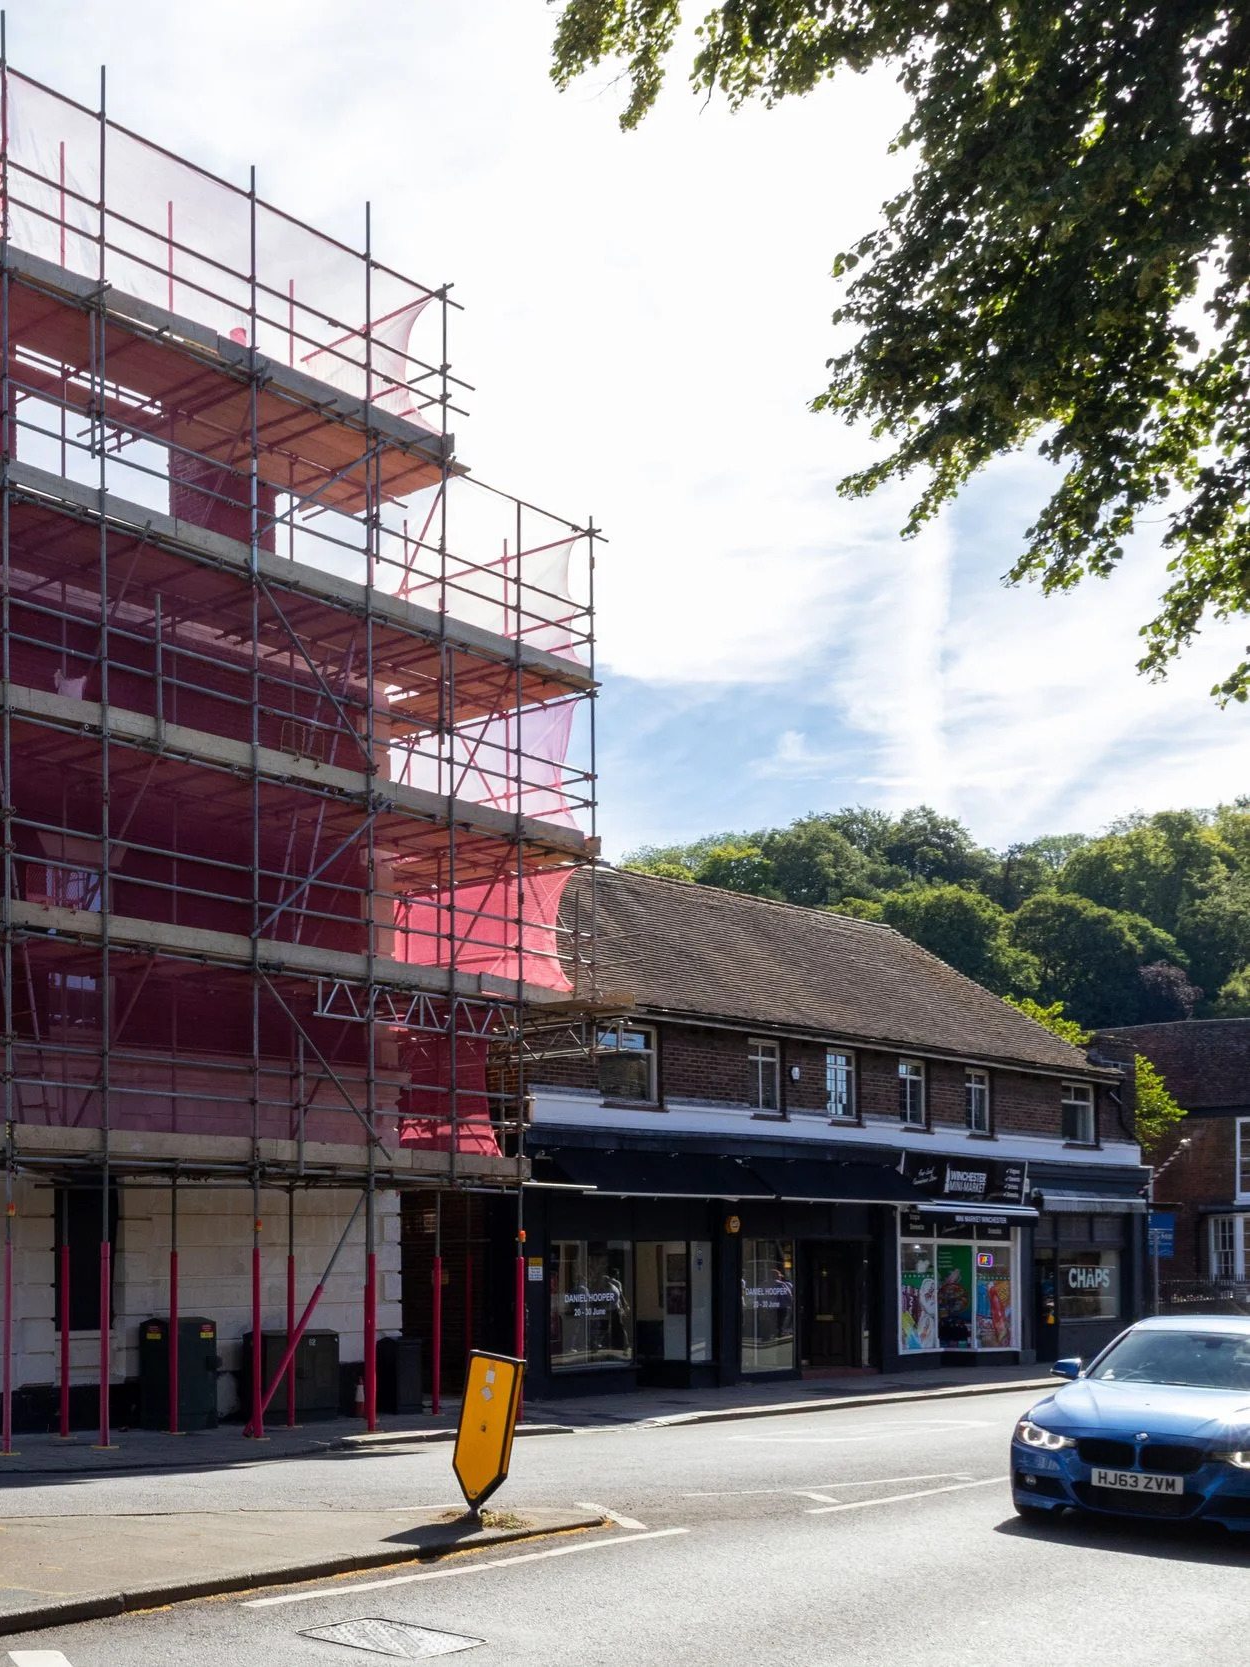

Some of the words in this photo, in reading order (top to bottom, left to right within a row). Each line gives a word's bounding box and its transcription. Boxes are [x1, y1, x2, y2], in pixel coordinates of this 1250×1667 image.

[950, 1170, 987, 1182] WINCHESTER
[949, 1181, 986, 1193] MINI-MARKET
[1068, 1268, 1110, 1288] CHAPS
[564, 1294, 588, 1303] DANIEL
[589, 1293, 615, 1302] HOOPER
[745, 1288, 764, 1296] DANIEL
[765, 1288, 787, 1296] HOOPER
[593, 1308, 606, 1316] June
[1097, 1470, 1139, 1488] HJ63
[1143, 1476, 1175, 1492] ZVM
